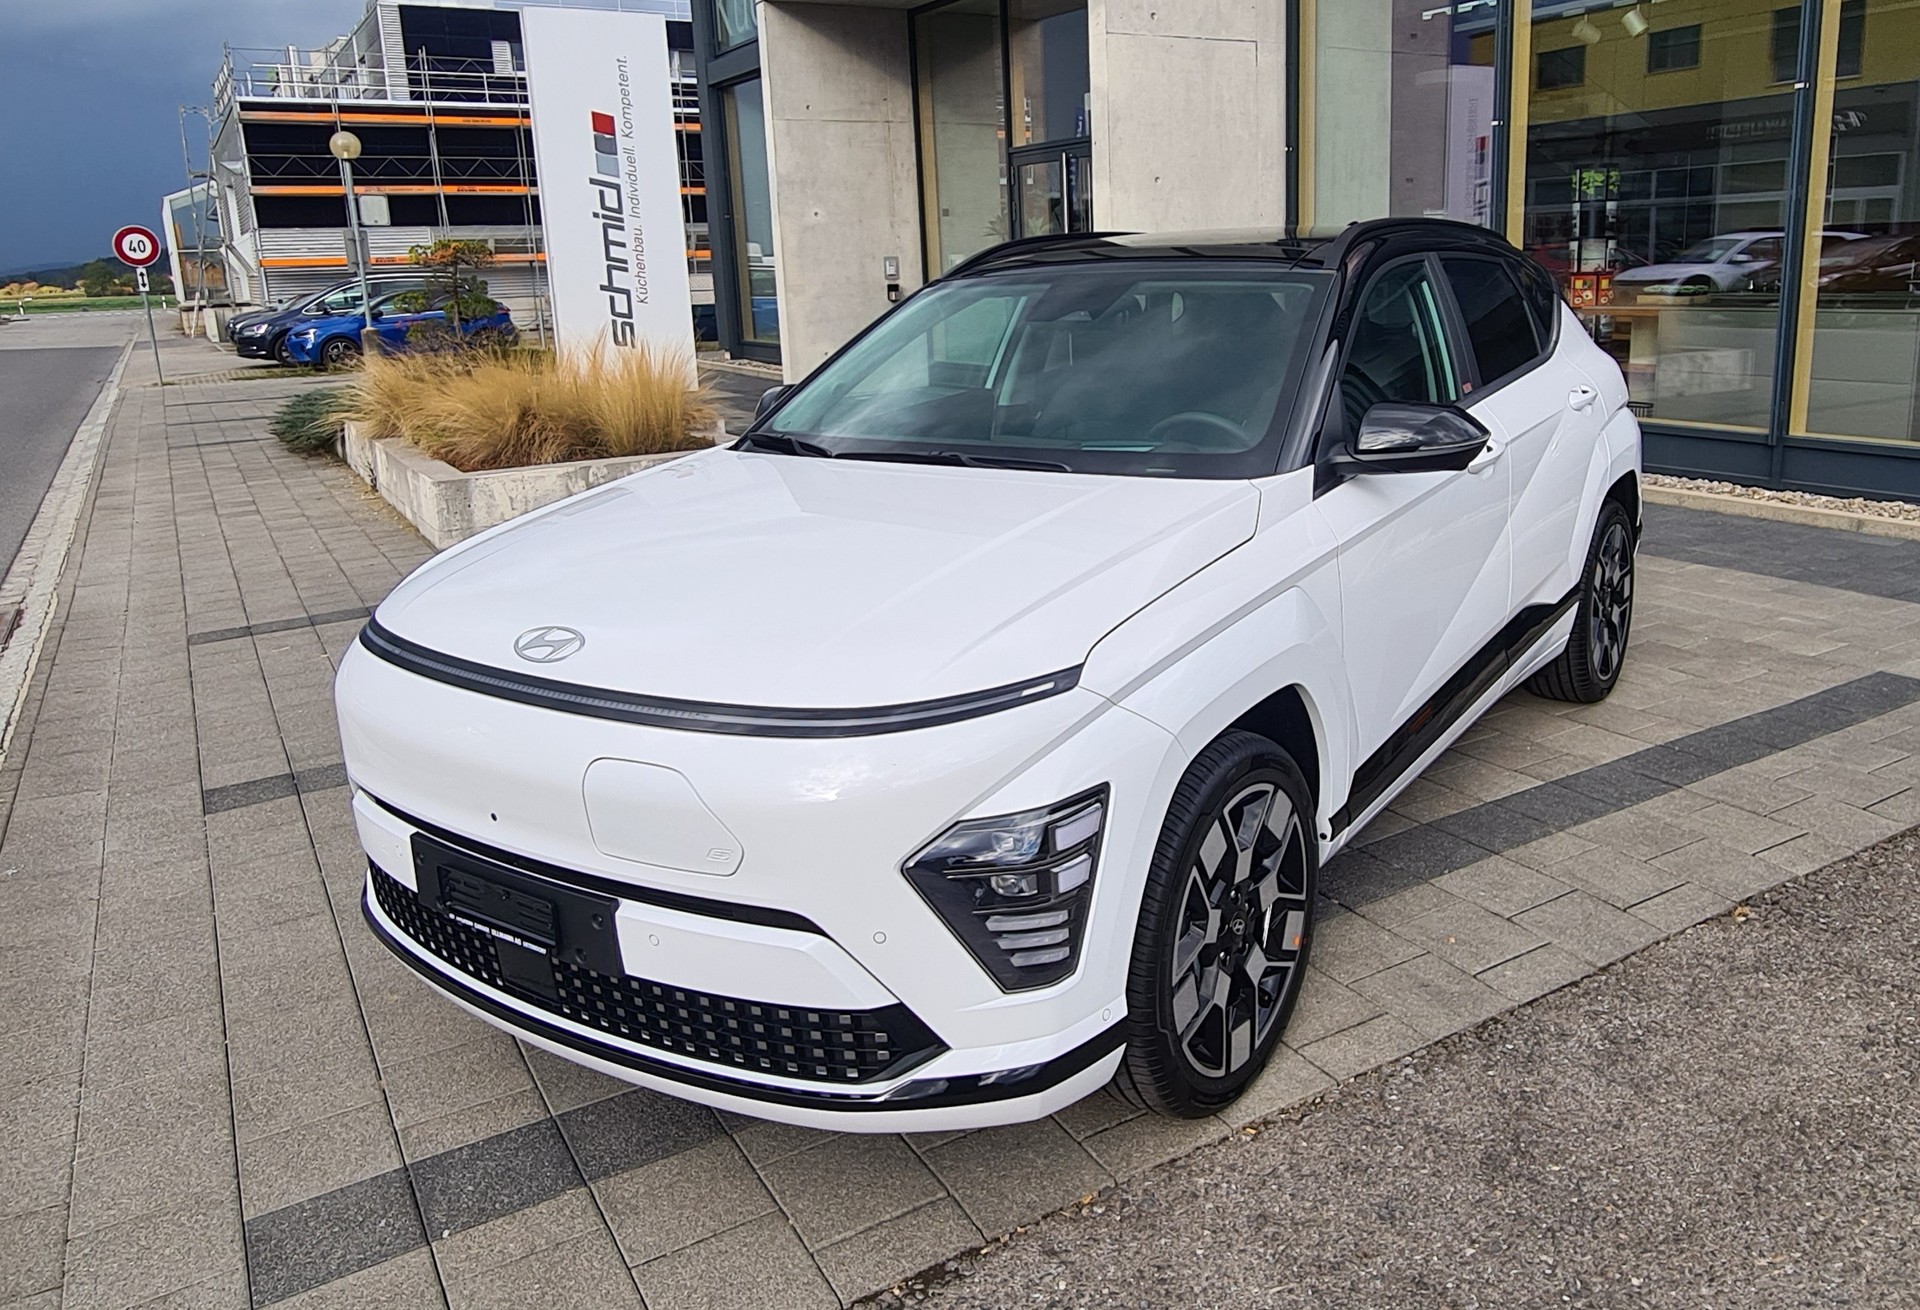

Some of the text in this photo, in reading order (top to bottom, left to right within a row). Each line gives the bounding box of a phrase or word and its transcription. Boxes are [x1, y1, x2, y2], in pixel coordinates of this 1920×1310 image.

[129, 239, 146, 253] 40
[589, 177, 636, 349] schmid
[616, 55, 649, 305] Küchenbau. Individuell. Kompetent.
